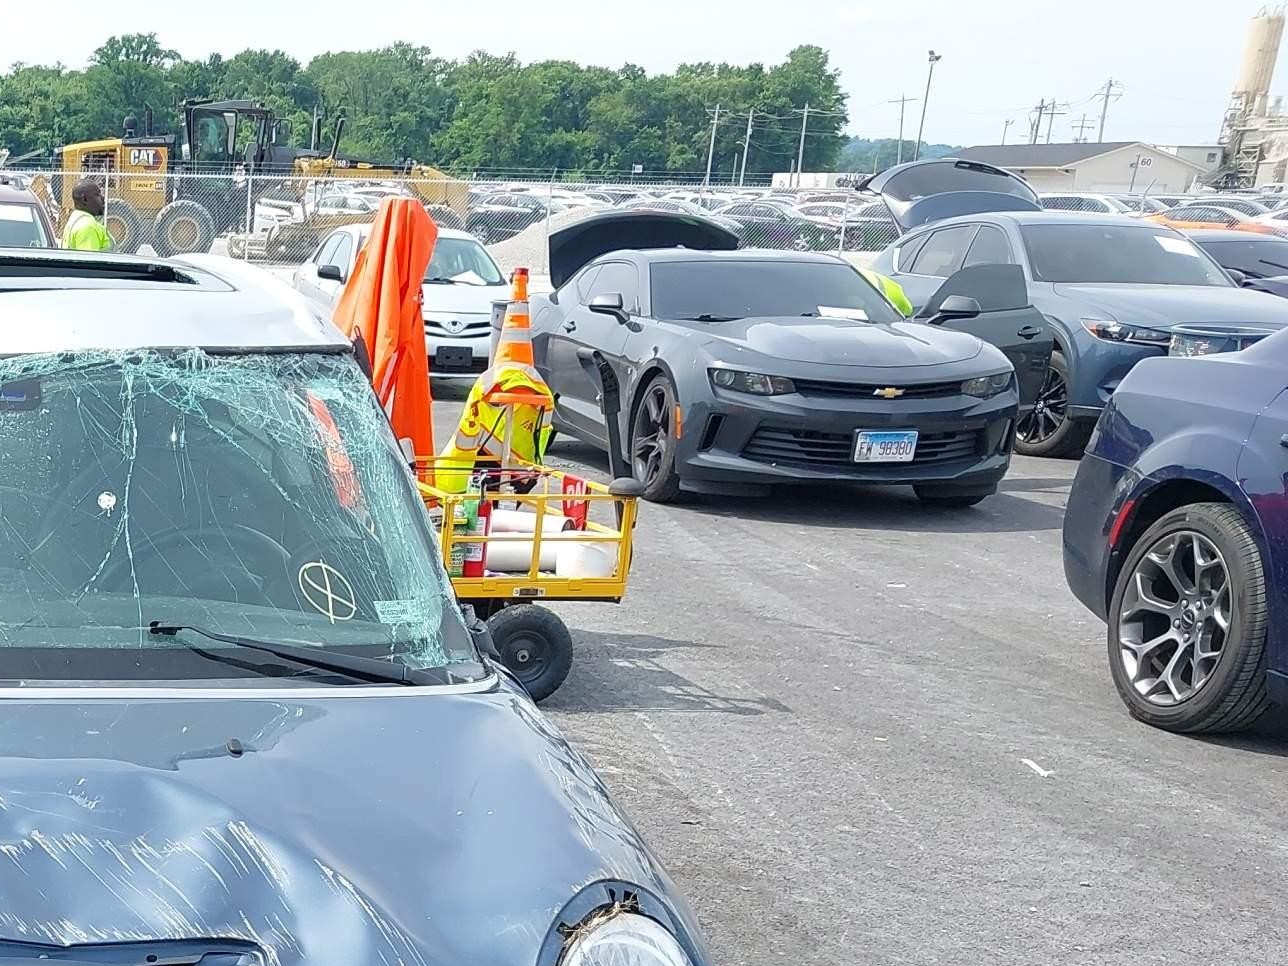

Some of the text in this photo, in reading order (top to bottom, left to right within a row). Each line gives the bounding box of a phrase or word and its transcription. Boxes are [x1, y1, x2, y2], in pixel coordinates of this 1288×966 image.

[130, 149, 156, 166] CAT
[1140, 158, 1152, 167] 60
[878, 440, 913, 456] 98380
